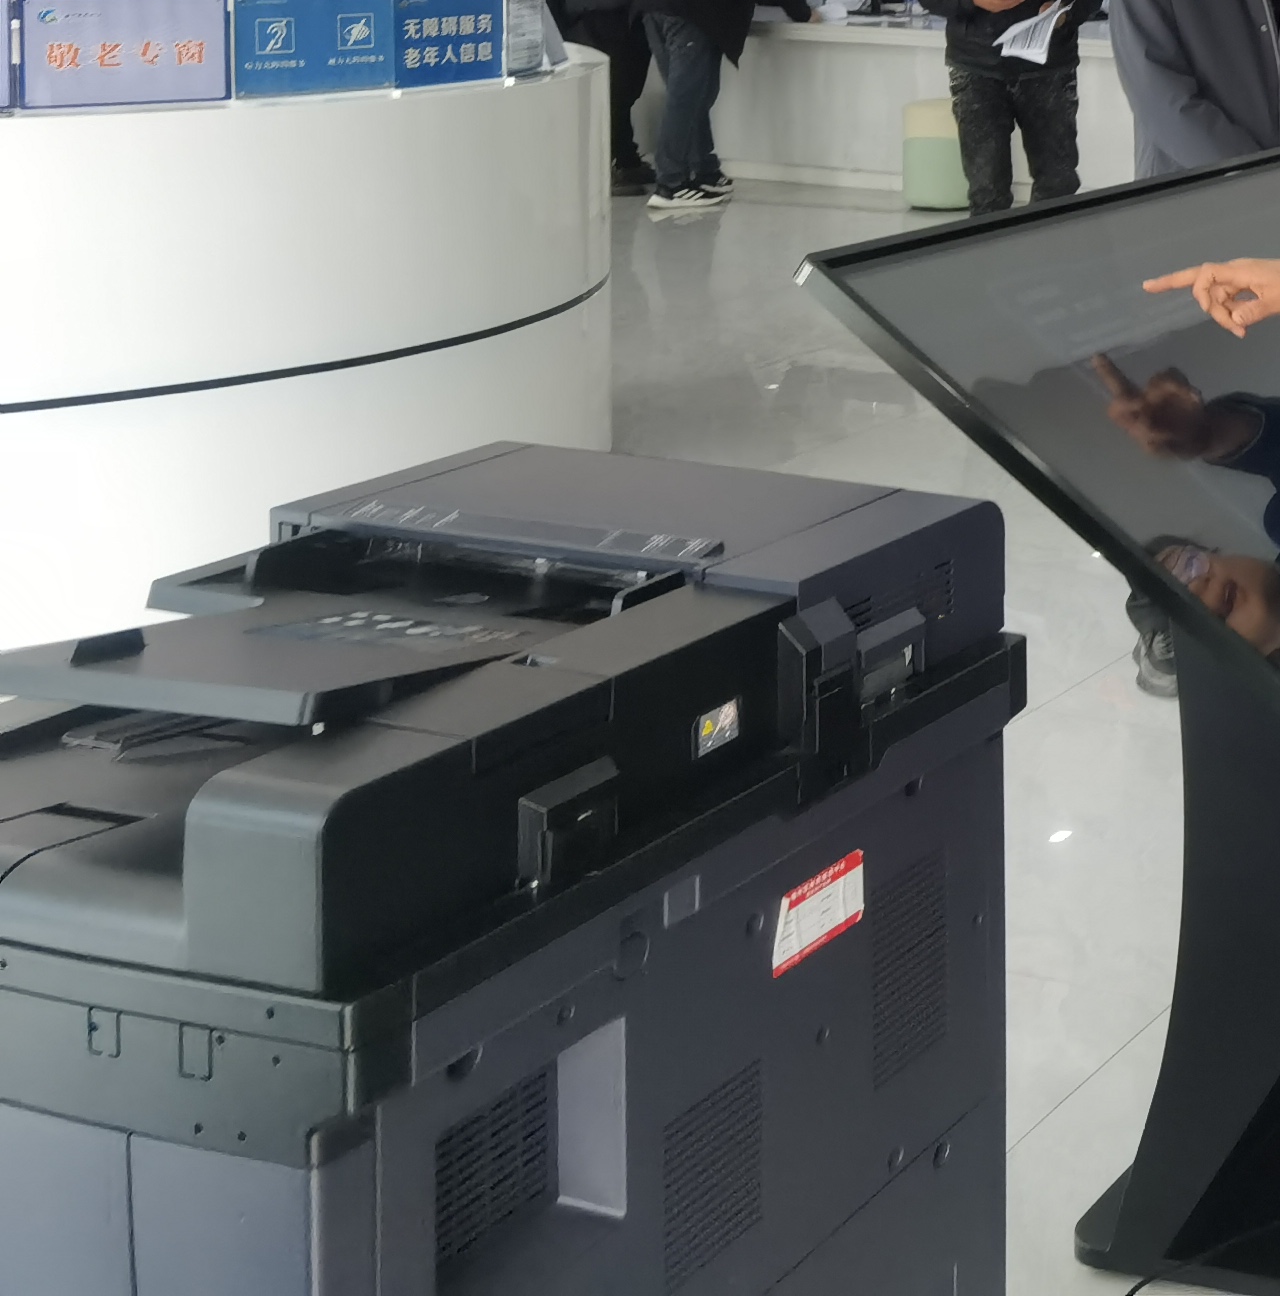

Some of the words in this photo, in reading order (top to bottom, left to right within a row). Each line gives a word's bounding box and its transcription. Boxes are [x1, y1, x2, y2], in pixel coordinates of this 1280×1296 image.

[403, 14, 493, 40] 无障碍服务
[46, 39, 207, 71] 敬老专窗
[404, 41, 493, 69] 老年人信息
